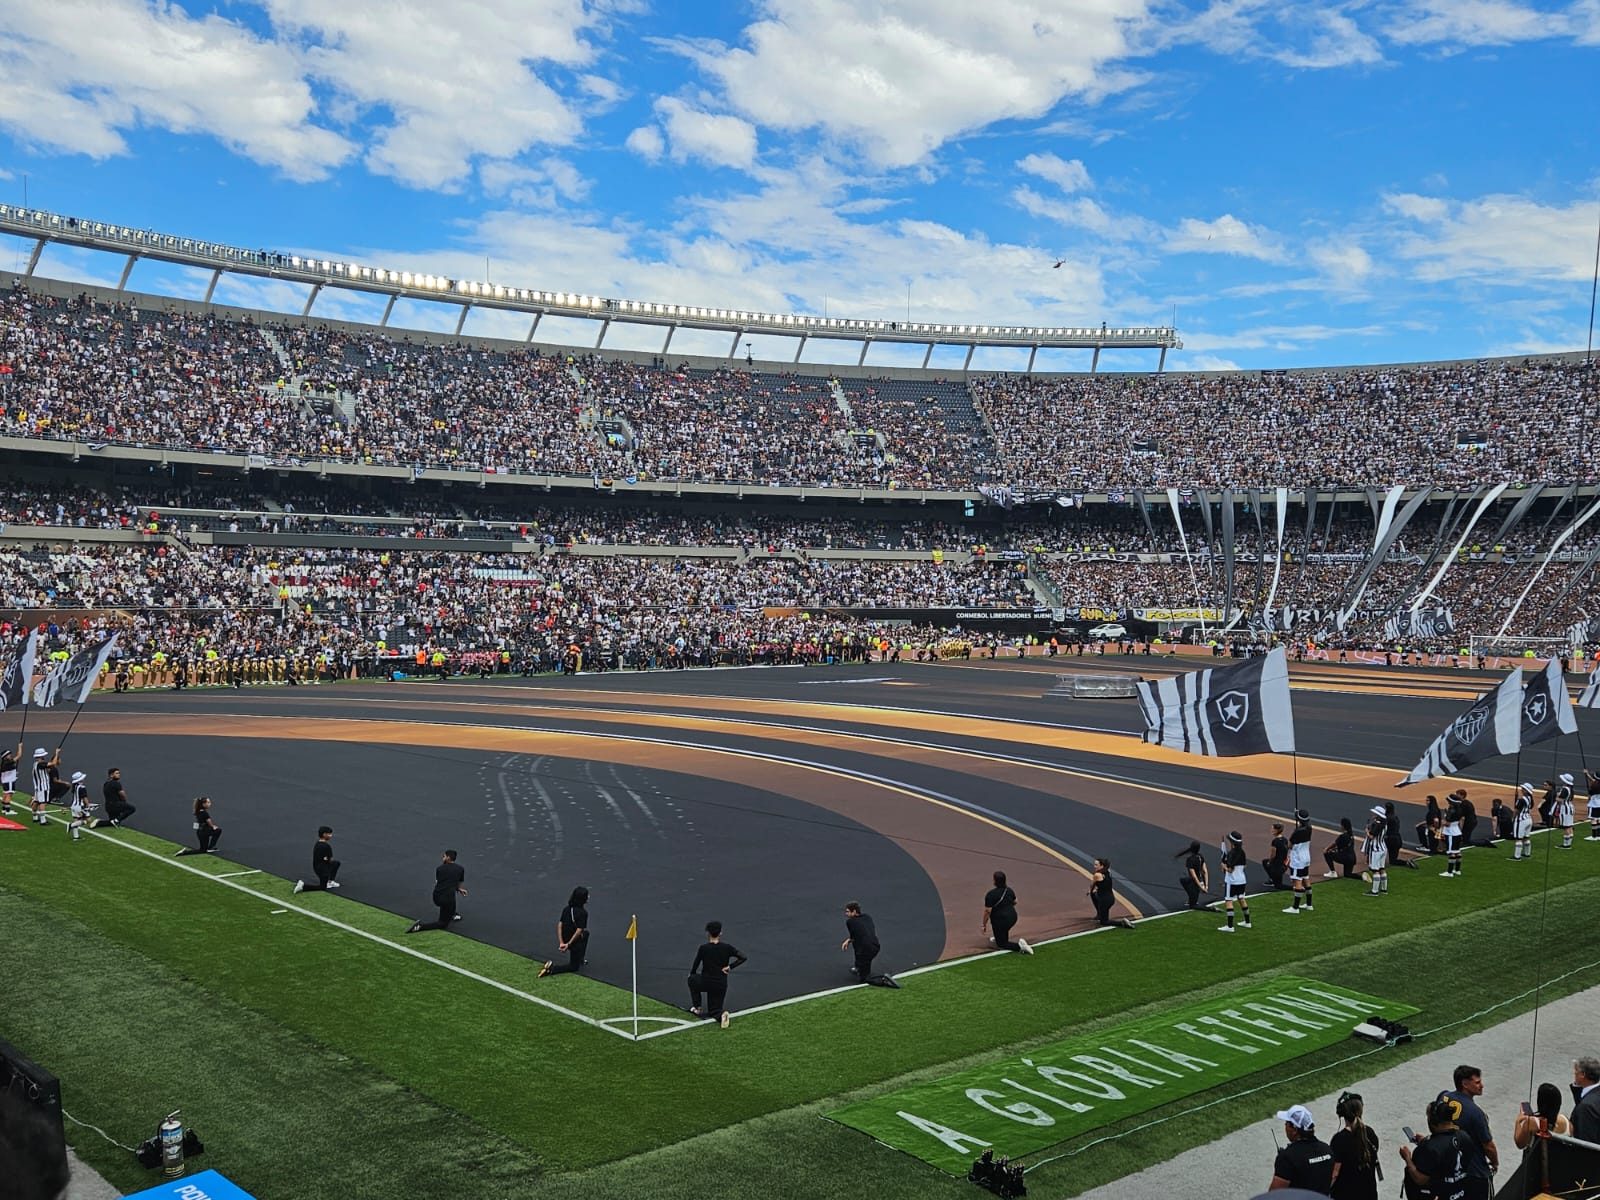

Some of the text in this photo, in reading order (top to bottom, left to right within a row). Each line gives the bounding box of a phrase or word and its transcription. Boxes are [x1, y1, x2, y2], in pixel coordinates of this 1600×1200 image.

[896, 986, 1384, 1154] A GLÓRIA ETERNA
